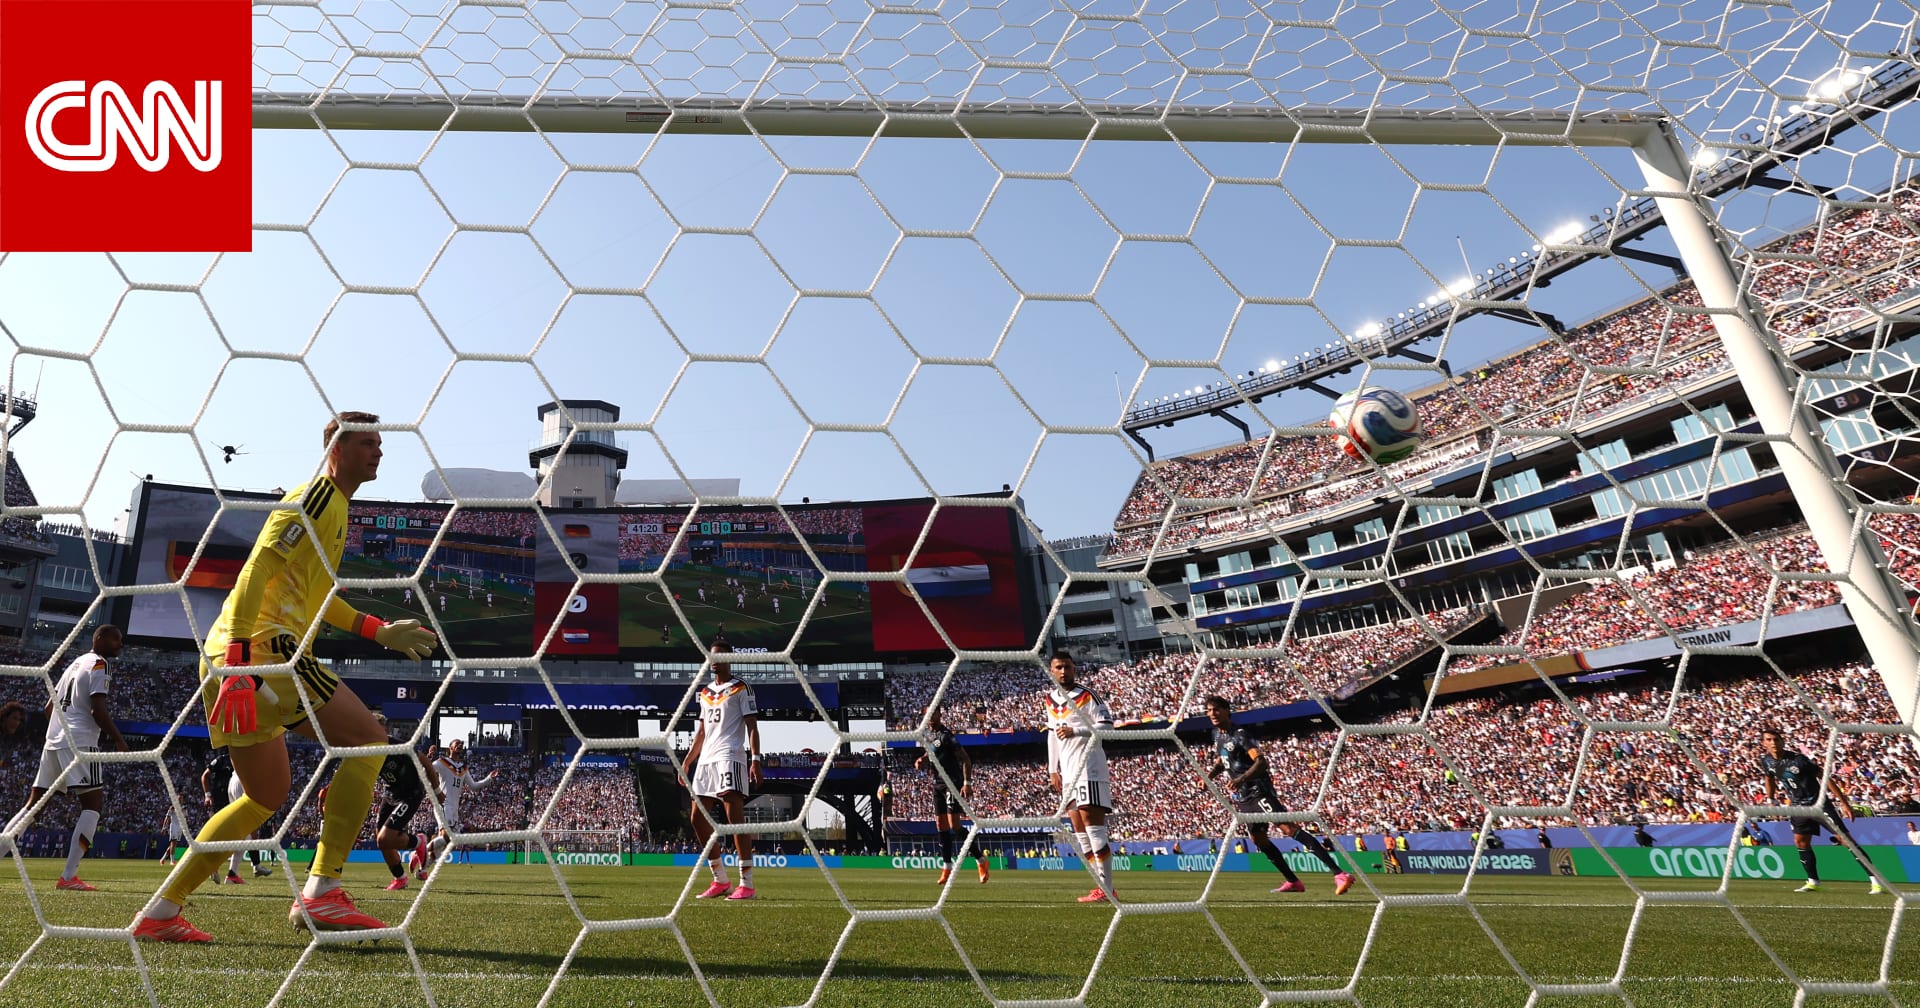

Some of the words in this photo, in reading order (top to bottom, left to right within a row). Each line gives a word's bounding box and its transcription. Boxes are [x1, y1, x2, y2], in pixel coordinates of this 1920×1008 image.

[361, 517, 374, 525] GER
[409, 519, 422, 527] PAR
[632, 525, 658, 533] 41:20
[731, 645, 768, 653] isense
[708, 709, 721, 723] 23
[640, 754, 670, 764] BOSTON
[452, 777, 460, 788] 19
[720, 771, 733, 789] 23
[1787, 778, 1798, 789] 6
[391, 802, 409, 817] 19
[1258, 798, 1273, 814] 15
[557, 852, 620, 866] aramco
[1039, 857, 1064, 871] aramco
[1177, 855, 1217, 871] aramco
[1408, 855, 1430, 869] FIFA
[1429, 855, 1467, 869] WORLD
[1490, 854, 1532, 870] 2026
[1649, 847, 1785, 879] aramco
